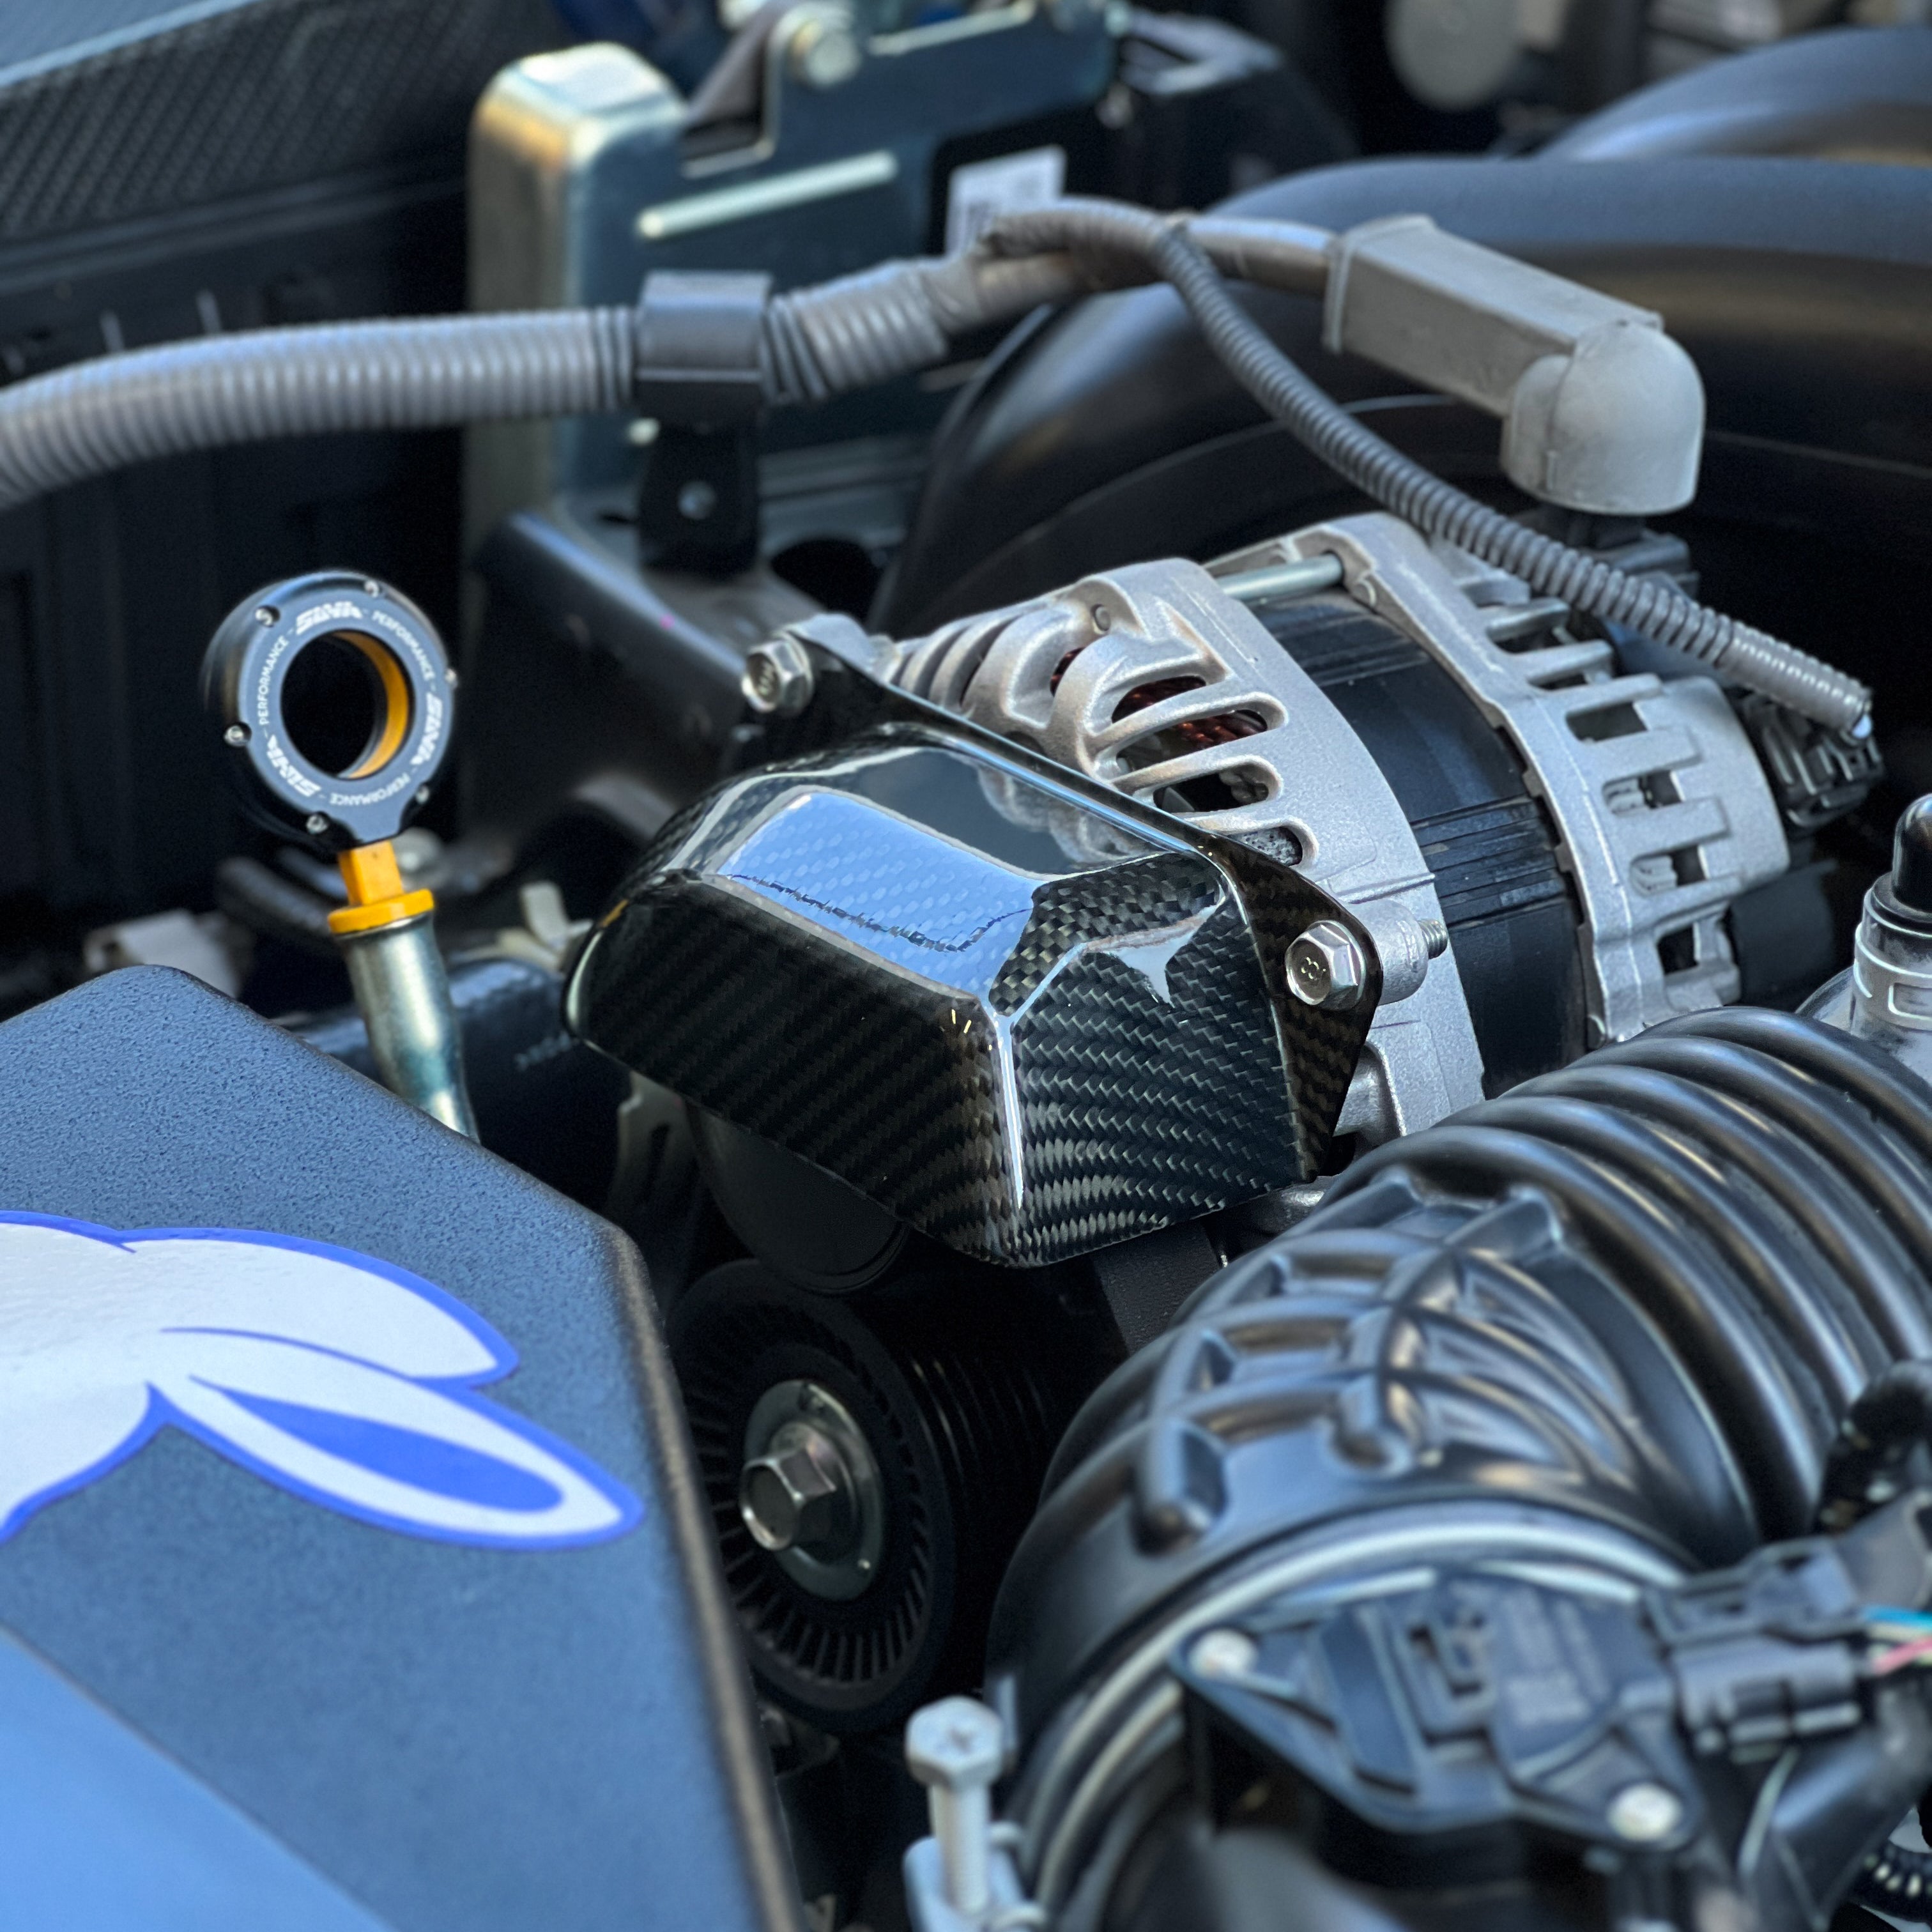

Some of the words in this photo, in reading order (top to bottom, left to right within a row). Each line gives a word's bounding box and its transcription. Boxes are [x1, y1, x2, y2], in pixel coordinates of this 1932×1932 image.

[257, 635, 289, 725] PERFORMANCE
[372, 611, 434, 681] PERFORMANCE
[330, 772, 411, 805] PERFORMANCE
